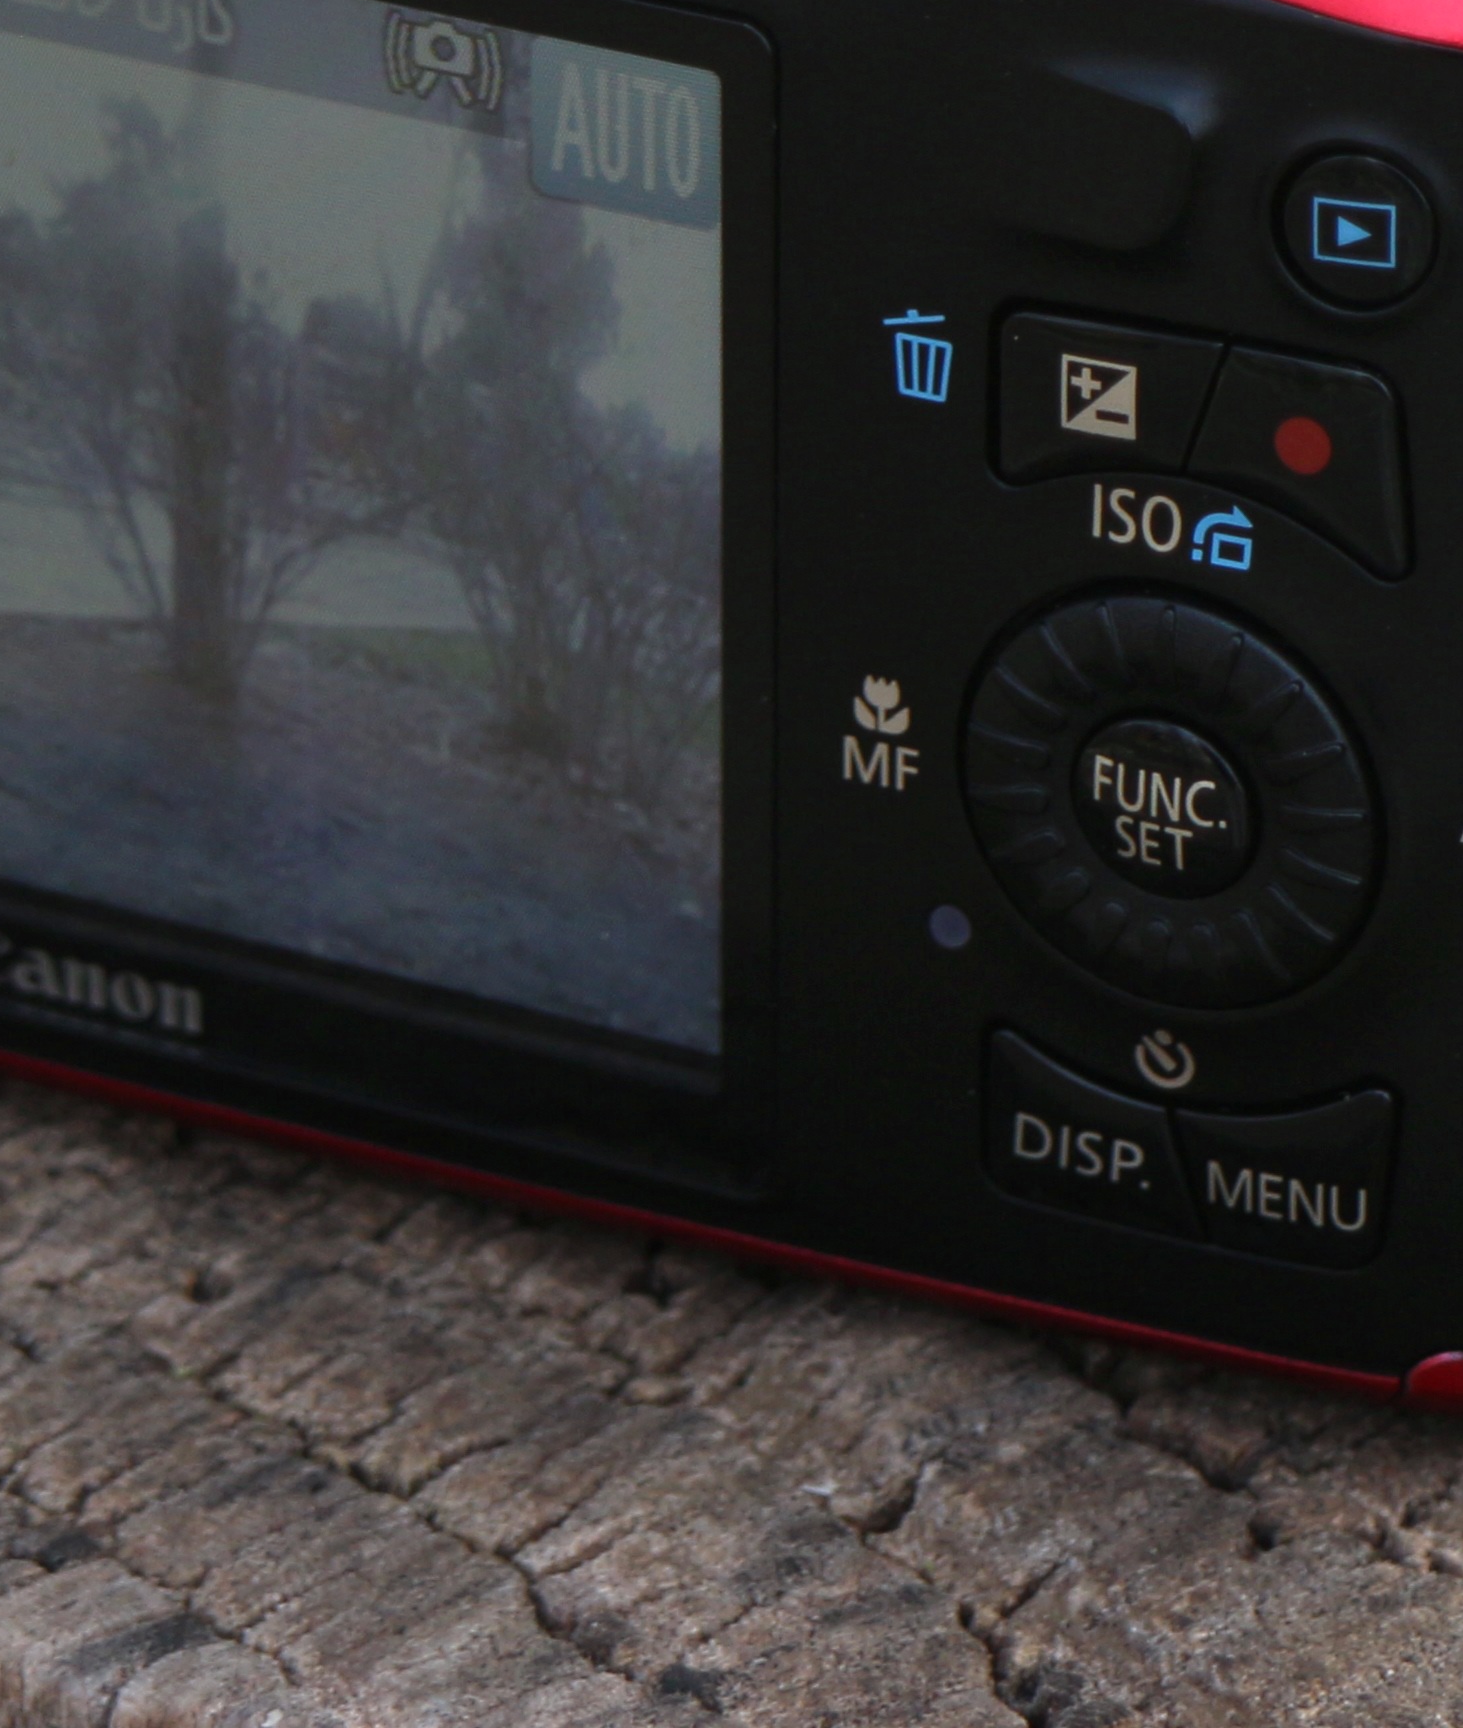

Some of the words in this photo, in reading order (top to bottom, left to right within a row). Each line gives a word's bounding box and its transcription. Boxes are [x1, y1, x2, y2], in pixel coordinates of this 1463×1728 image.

[551, 61, 701, 198] AUTO
[1091, 484, 1182, 552] ISO
[842, 736, 920, 791] MF
[1092, 754, 1228, 830] FUNC.
[1114, 814, 1194, 870] SET
[1012, 1112, 1150, 1190] DISP.
[1207, 1161, 1368, 1232] MENU
